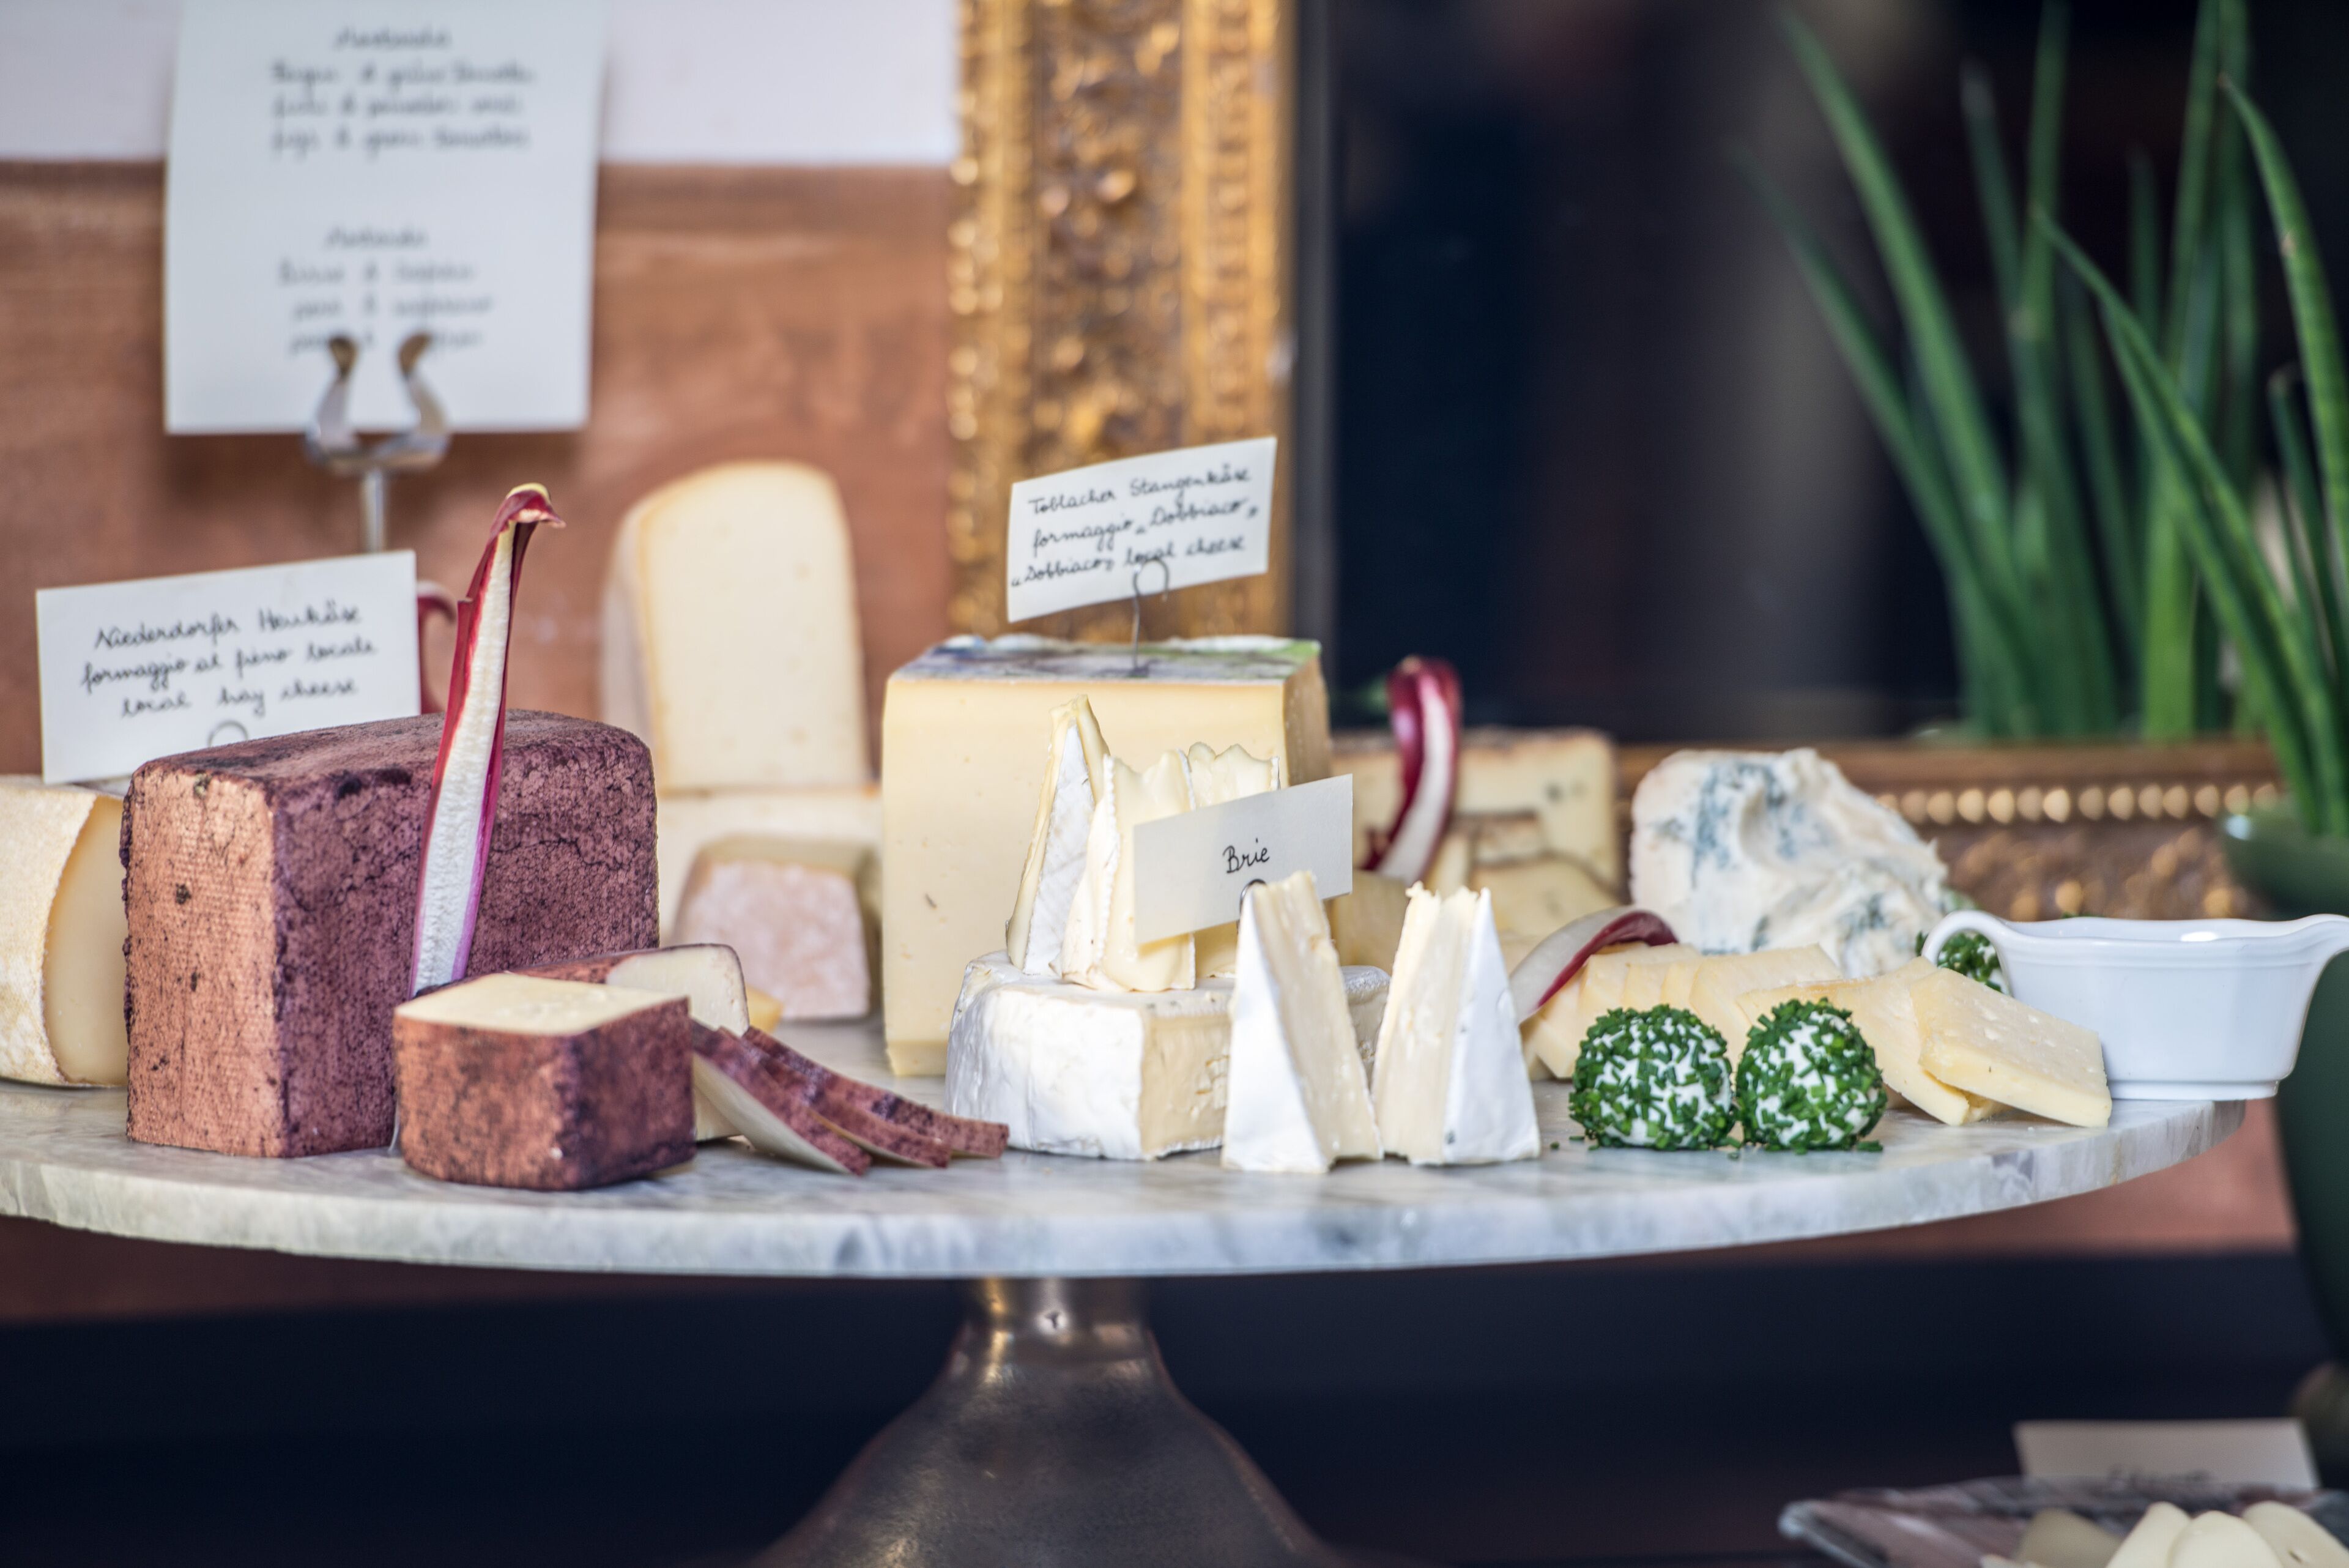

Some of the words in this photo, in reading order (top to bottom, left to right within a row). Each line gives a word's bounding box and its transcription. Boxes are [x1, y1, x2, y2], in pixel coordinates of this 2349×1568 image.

[1033, 512, 1133, 559] formaggio
[1186, 535, 1245, 558] cheese
[81, 652, 191, 694] formaggio
[306, 634, 378, 663] locale
[121, 691, 191, 719] local
[280, 677, 358, 702] cheese
[1222, 838, 1271, 874] Brie
